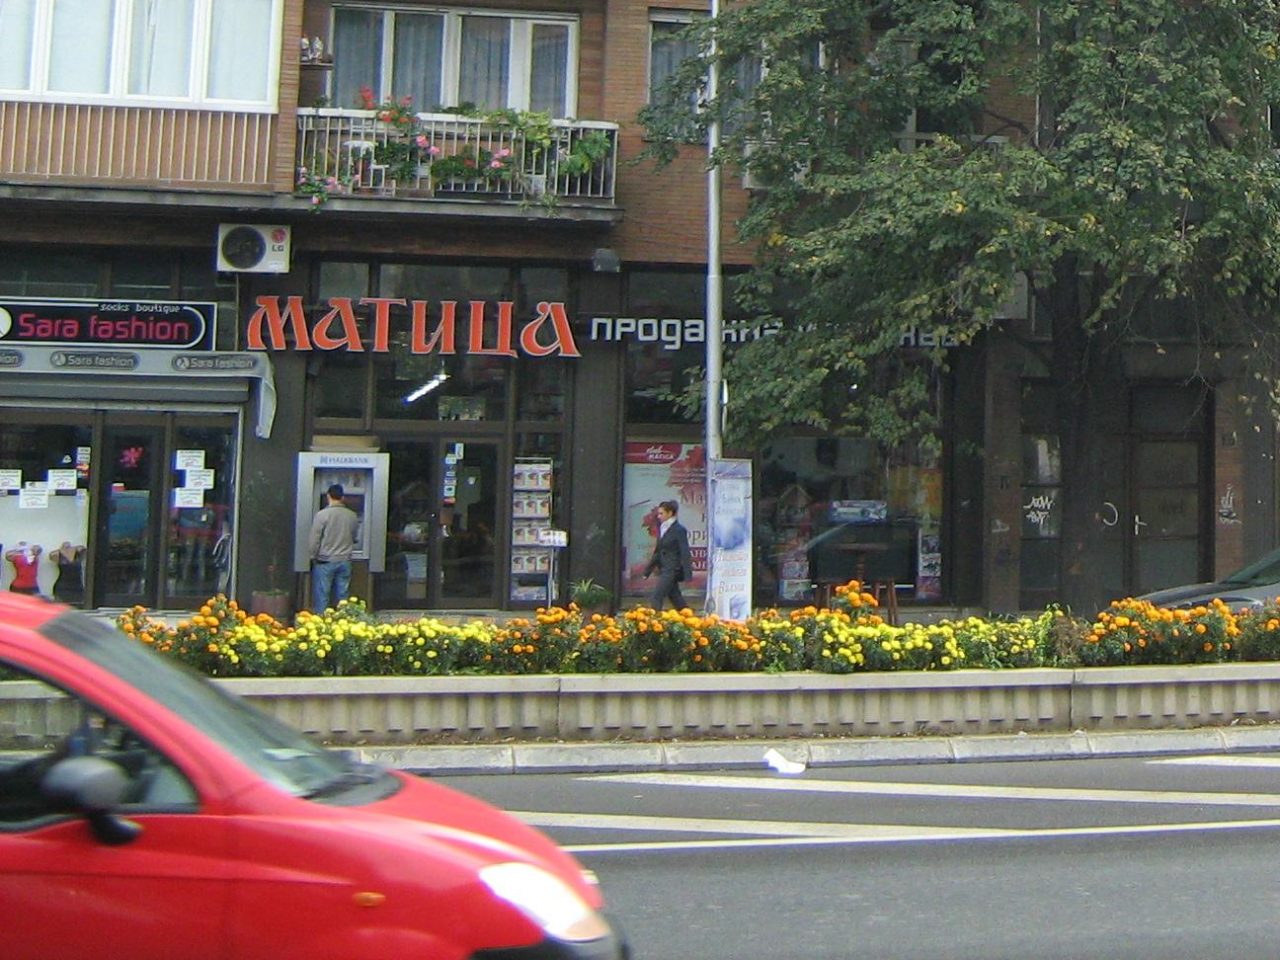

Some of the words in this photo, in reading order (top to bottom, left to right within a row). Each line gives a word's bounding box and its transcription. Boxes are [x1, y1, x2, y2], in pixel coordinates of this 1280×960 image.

[271, 244, 284, 253] LG
[99, 303, 131, 312] socks
[135, 303, 181, 314] boutique
[18, 314, 79, 337] Sara
[90, 315, 189, 340] fashion
